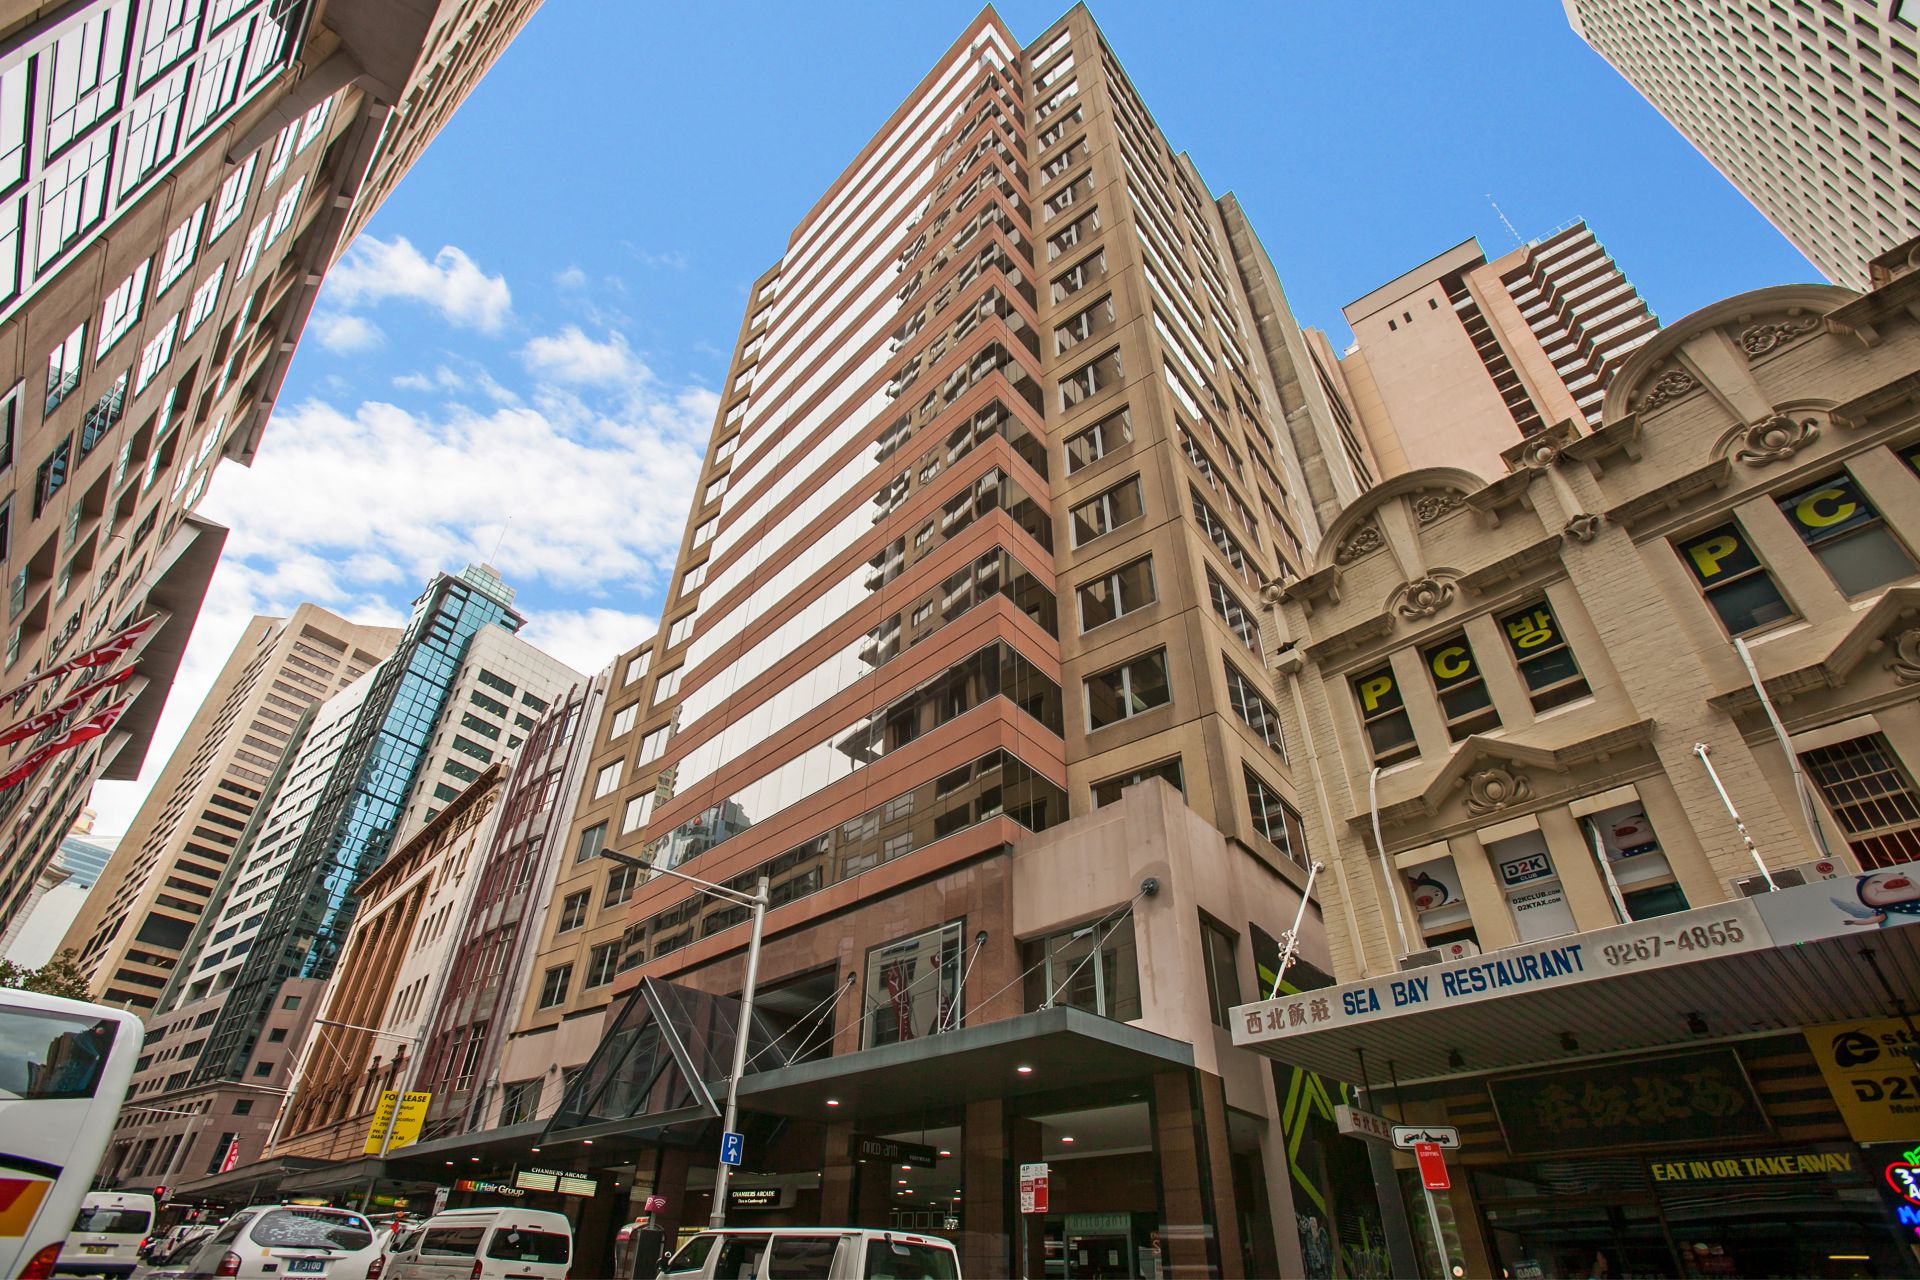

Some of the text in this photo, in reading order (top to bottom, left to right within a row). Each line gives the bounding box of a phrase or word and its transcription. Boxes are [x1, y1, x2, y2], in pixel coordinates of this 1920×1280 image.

[1507, 858, 1543, 876] D2K
[1603, 919, 1745, 966] 9267-4855
[1342, 944, 1584, 1016] SEA BAY RESTAURANT
[1244, 998, 1331, 1035] 西北飯莊
[728, 1136, 738, 1148] P
[1651, 1162, 1688, 1181] EAT
[1689, 1161, 1713, 1179] IN
[1712, 1159, 1744, 1177] OR
[480, 1181, 498, 1192] Hair
[498, 1185, 525, 1197] Group
